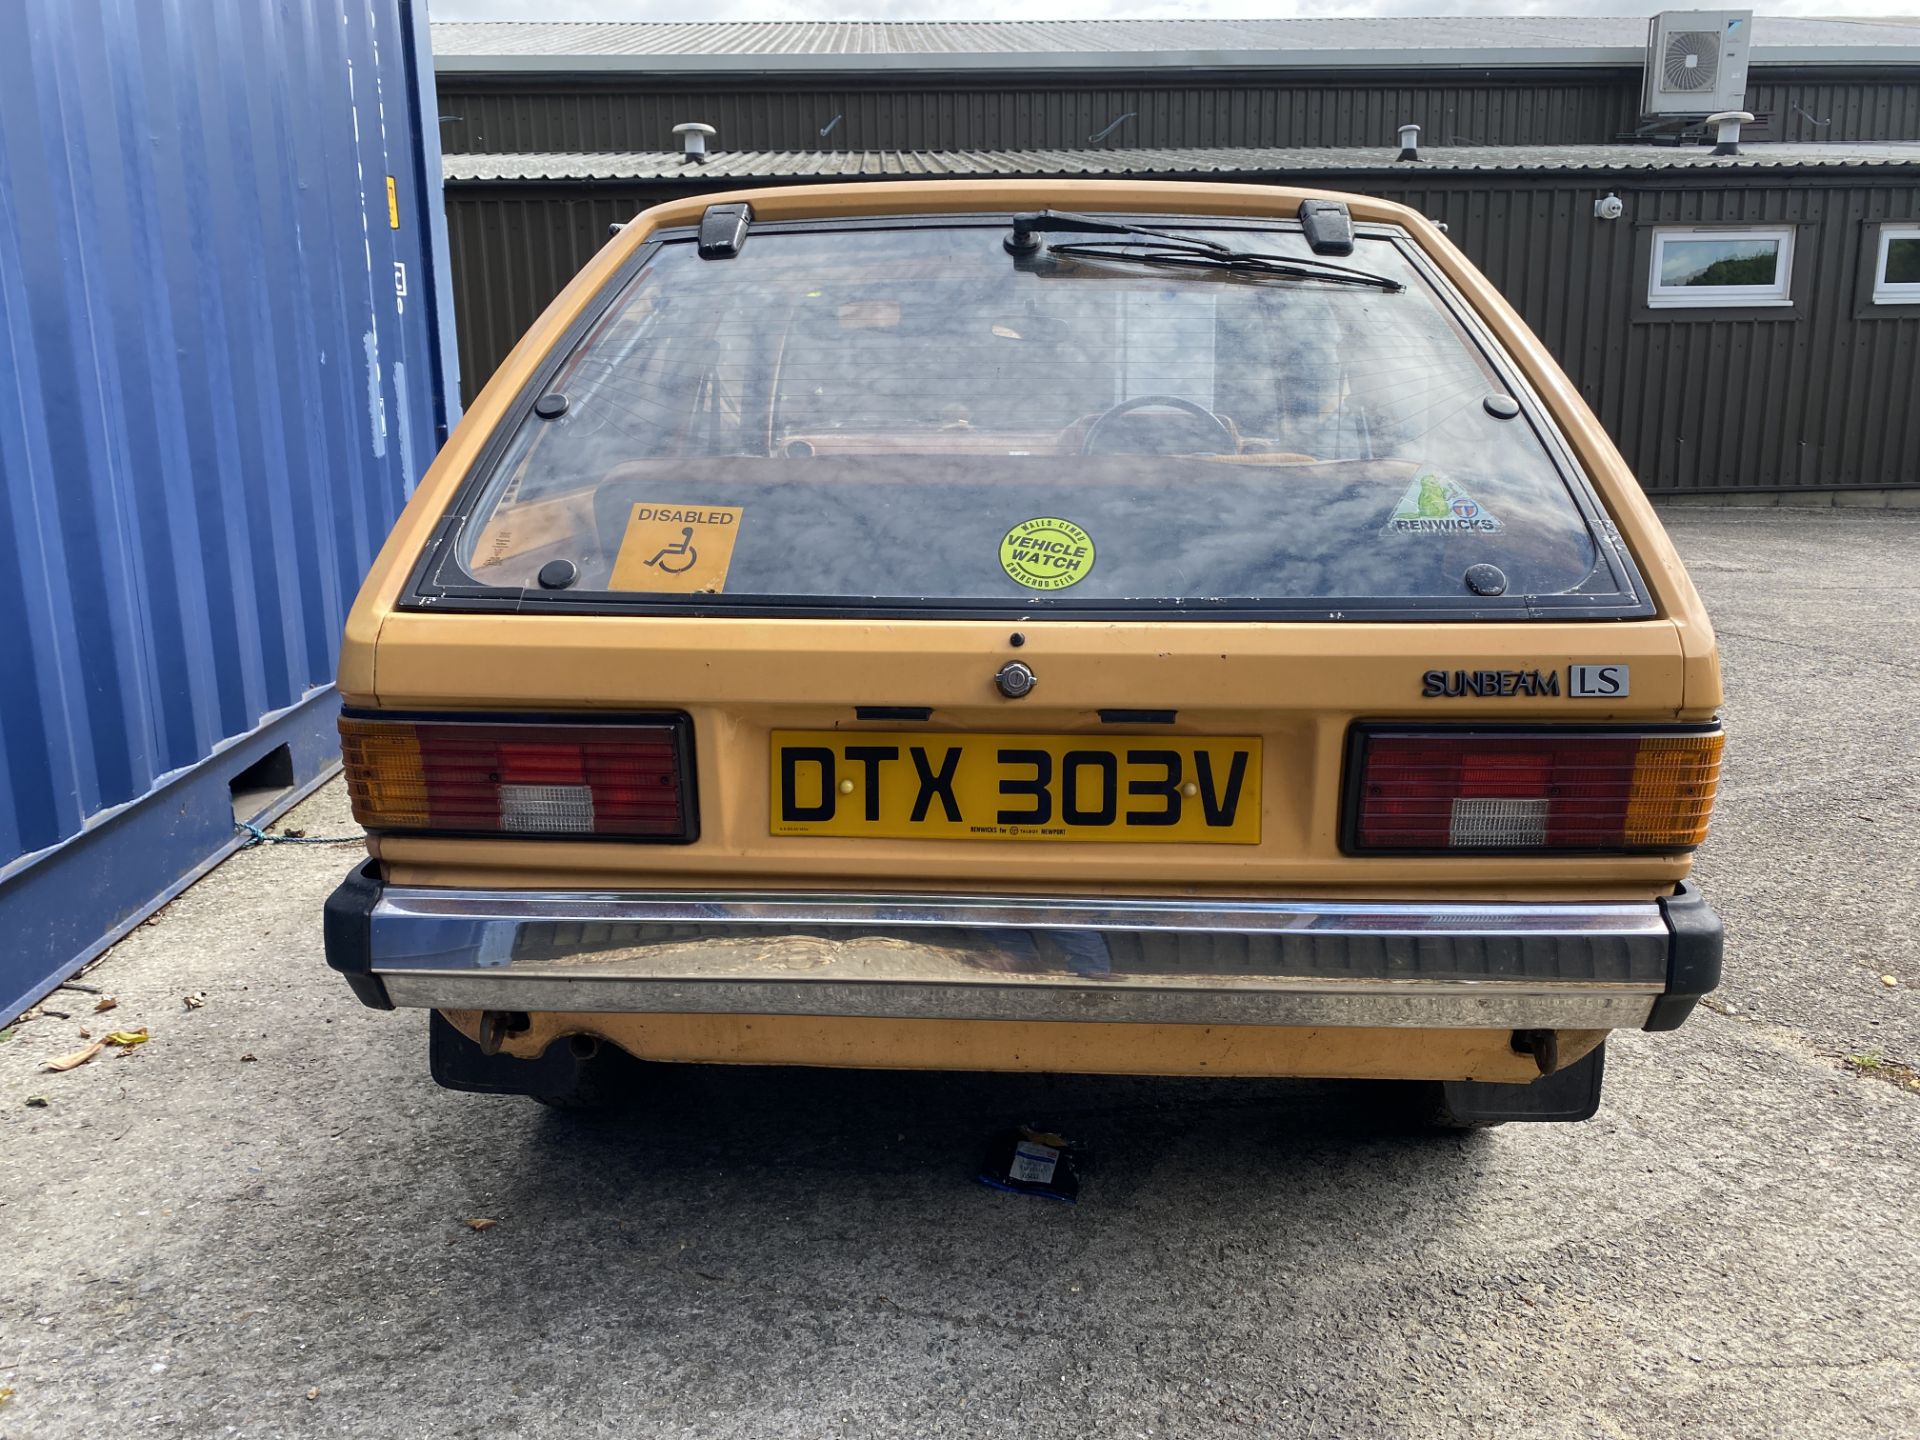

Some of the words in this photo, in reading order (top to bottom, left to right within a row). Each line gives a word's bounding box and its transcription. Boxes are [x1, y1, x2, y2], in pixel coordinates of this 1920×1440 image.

[638, 508, 734, 525] DISABLED
[1021, 520, 1053, 532] WALES
[1397, 519, 1495, 531] RENWICKS
[1007, 534, 1089, 559] VEHICLE
[1012, 549, 1082, 571] WATCH
[1421, 669, 1561, 698] SUNBEAM
[1578, 667, 1621, 695] LS
[780, 746, 963, 823] DTX
[996, 748, 1249, 828] 303V
